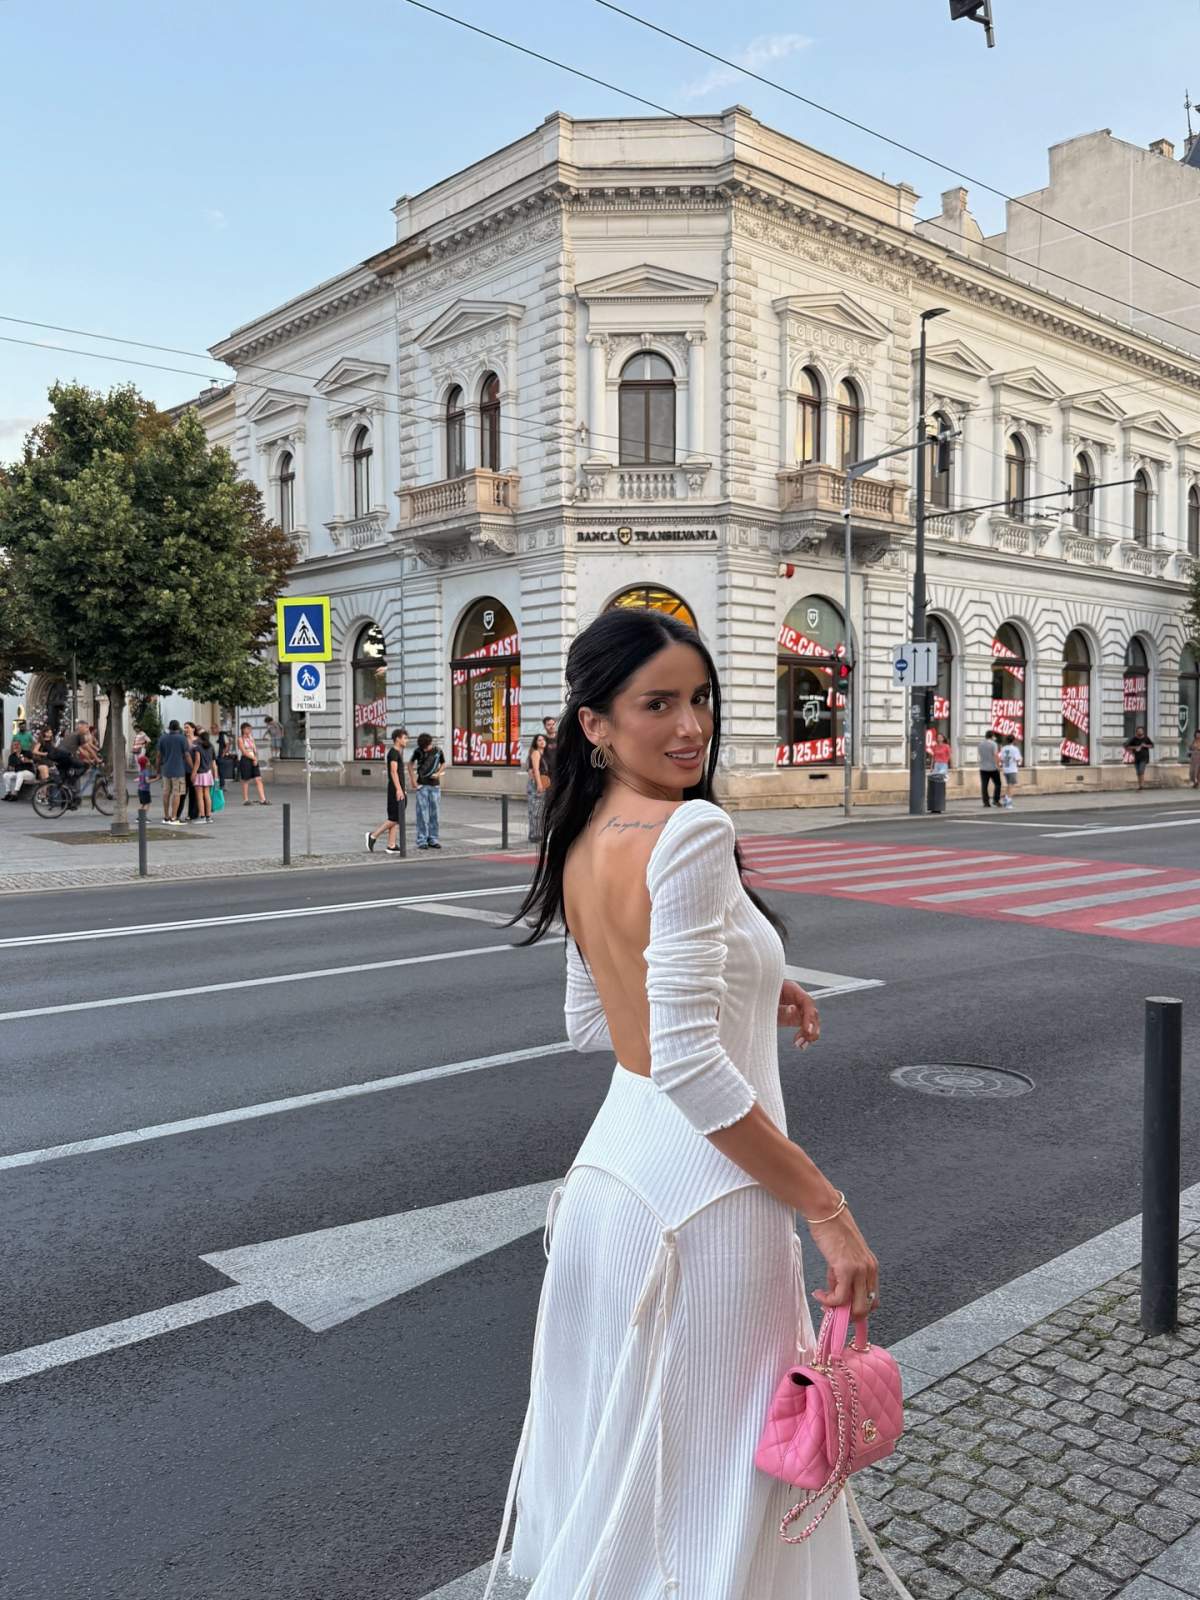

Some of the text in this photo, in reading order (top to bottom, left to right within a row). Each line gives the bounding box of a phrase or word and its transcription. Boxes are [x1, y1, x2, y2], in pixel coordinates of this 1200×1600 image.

[577, 531, 616, 542] BANCA
[634, 530, 718, 541] TRANSILVANIA
[992, 700, 1023, 717] ECTRIC
